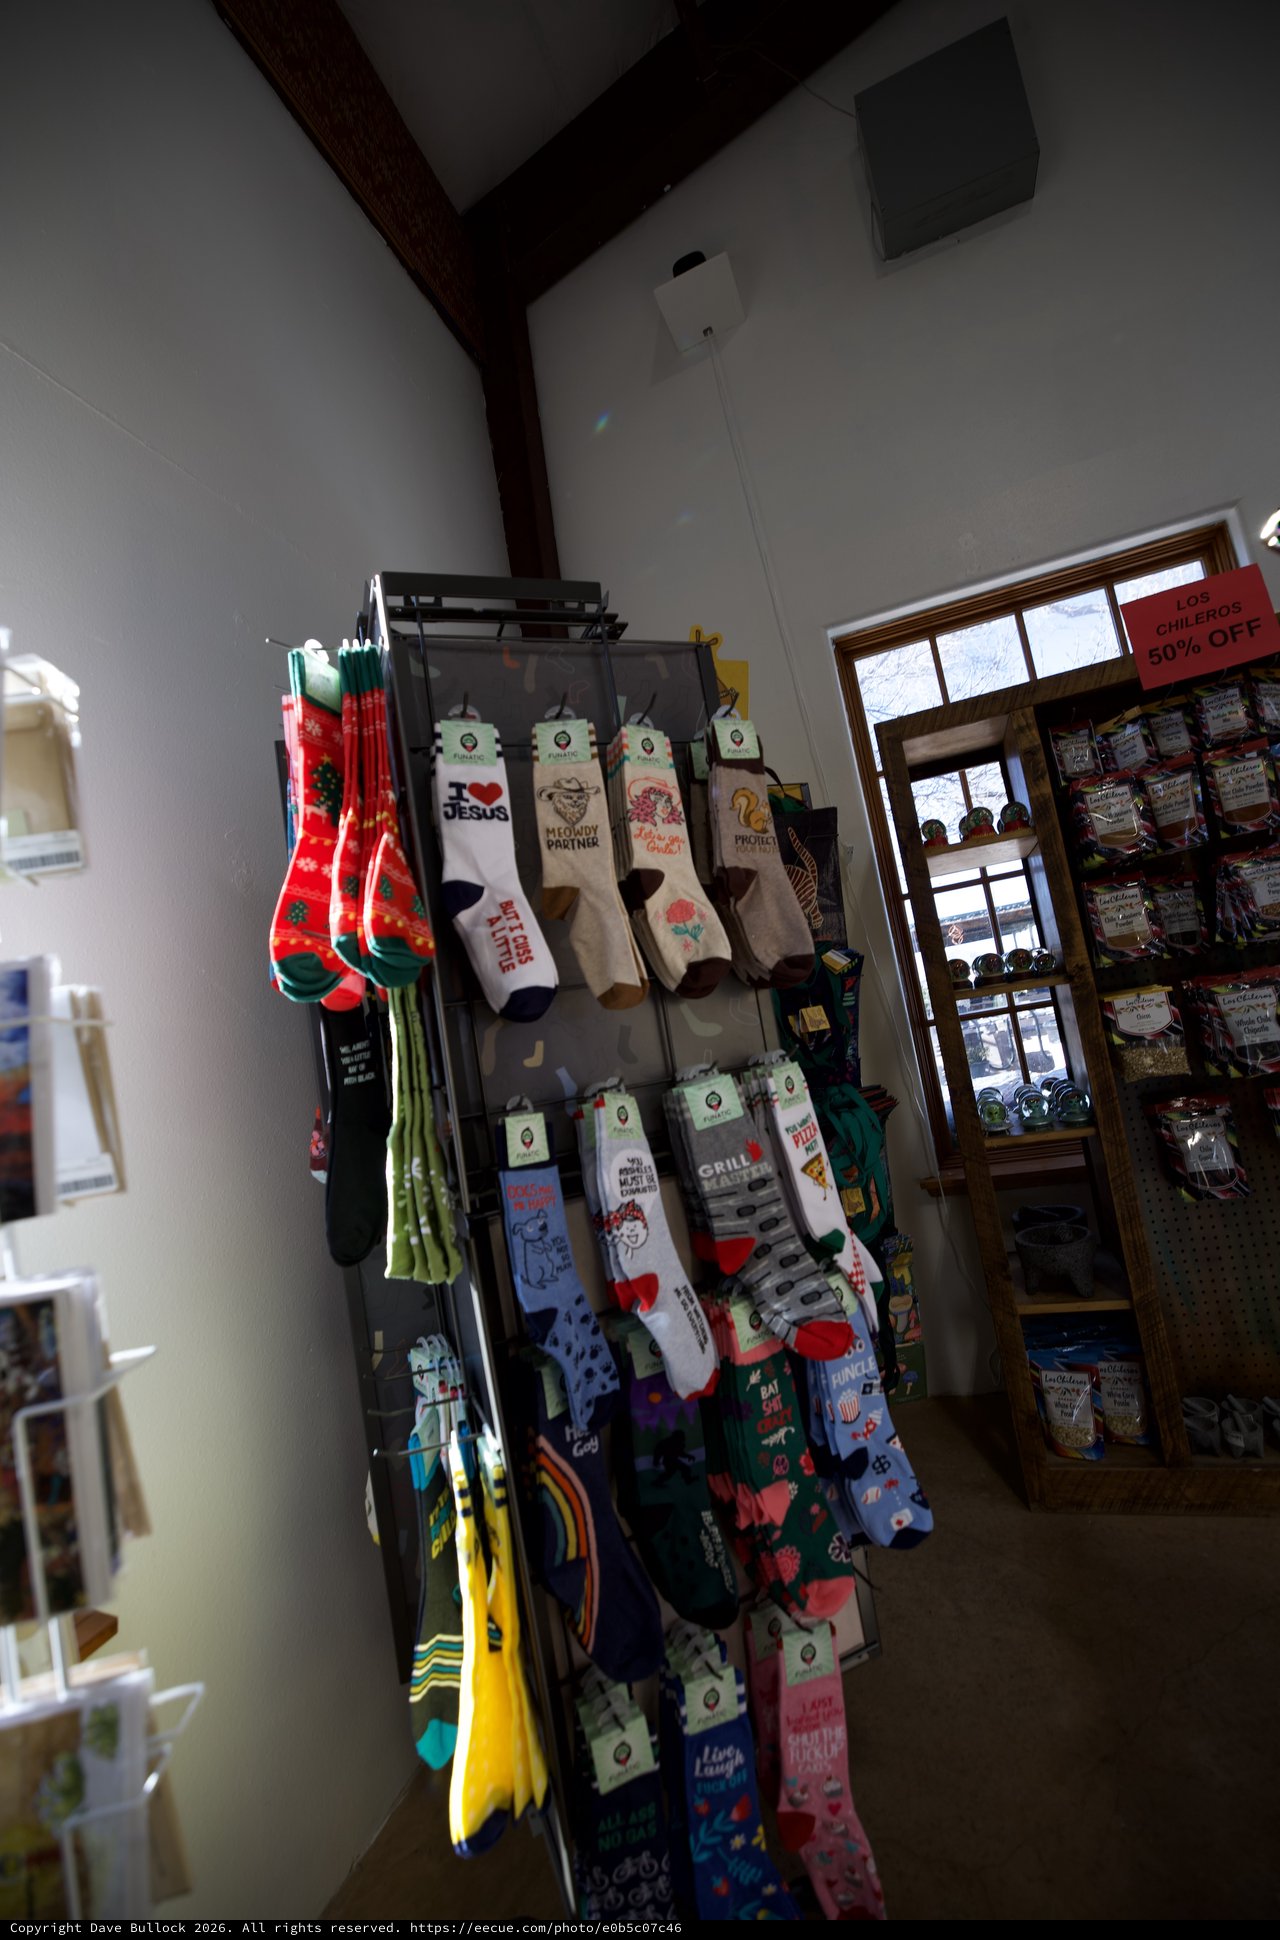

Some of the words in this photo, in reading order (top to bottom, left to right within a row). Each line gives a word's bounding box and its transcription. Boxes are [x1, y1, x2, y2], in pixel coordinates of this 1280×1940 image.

[1177, 592, 1210, 611] LOS
[1156, 602, 1242, 636] CHILEROS
[1148, 637, 1201, 665] 50%
[1209, 618, 1262, 648] OFF
[453, 753, 485, 761] FUNATIC
[548, 751, 578, 759] FUNATIC
[448, 782, 469, 802] I
[443, 802, 509, 821] JESUS
[546, 825, 598, 838] MEOWDY
[735, 835, 776, 846] PROTECT
[547, 837, 599, 850] PARTNER
[499, 900, 520, 921] BUT
[487, 915, 502, 927] A
[509, 923, 524, 932] I
[491, 927, 516, 974] LITTLE
[513, 935, 534, 965] CUSS
[1243, 1025, 1269, 1035] Chipotle
[792, 1121, 817, 1149] PIZZA
[698, 1153, 750, 1177] GRILL
[619, 1175, 643, 1187] MUST
[646, 1174, 656, 1184] BE
[701, 1162, 773, 1191] MASTER
[507, 1184, 537, 1200] DOGS
[527, 1196, 557, 1211] HAPPY
[831, 1357, 876, 1389] FUNCLE
[1056, 1374, 1086, 1385] Chileros
[760, 1379, 779, 1400] BAT
[762, 1394, 783, 1416] SHIT
[757, 1405, 793, 1434] CRAZY
[572, 1434, 599, 1457] Gay
[694, 1747, 745, 1778] Laugh
[702, 1744, 736, 1764] Live
[695, 1778, 727, 1795] FUCK
[597, 1808, 625, 1834] ALL
[597, 1830, 623, 1852] NO
